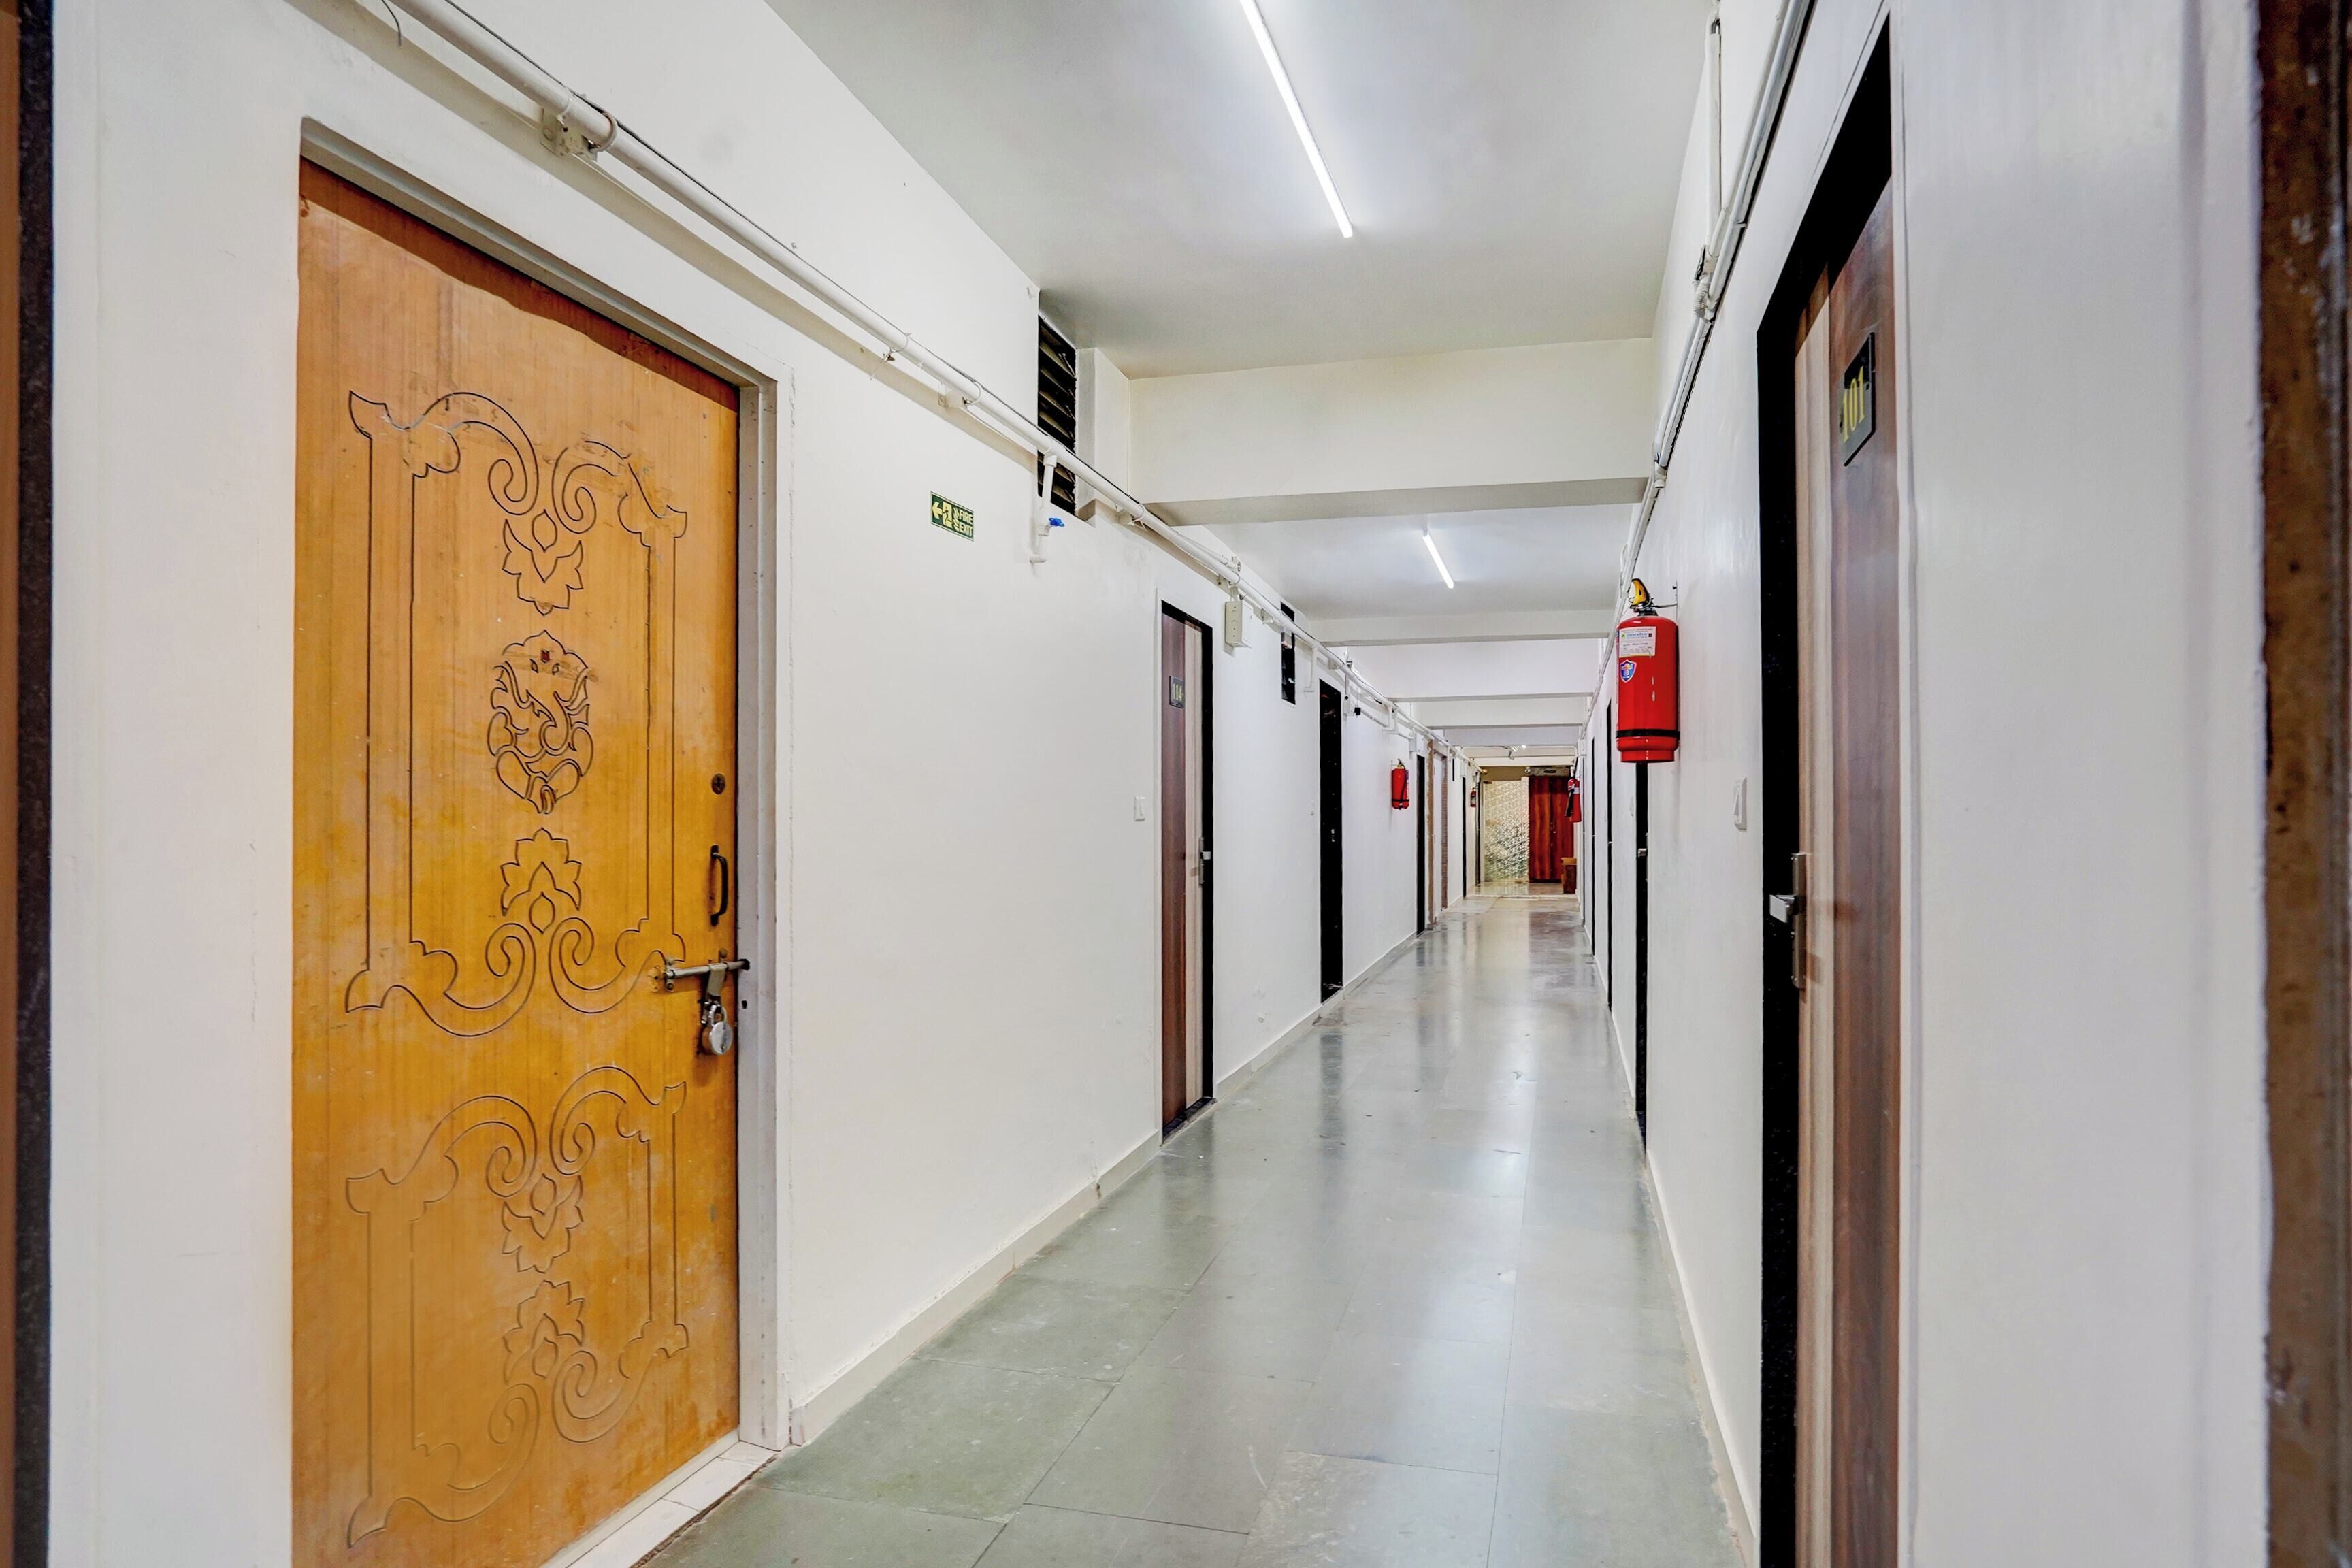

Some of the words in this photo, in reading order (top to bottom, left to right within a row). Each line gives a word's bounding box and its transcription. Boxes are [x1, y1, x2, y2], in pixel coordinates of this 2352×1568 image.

[1842, 365, 1865, 443] 101
[959, 509, 973, 524] FIRE
[959, 522, 973, 536] EXIT
